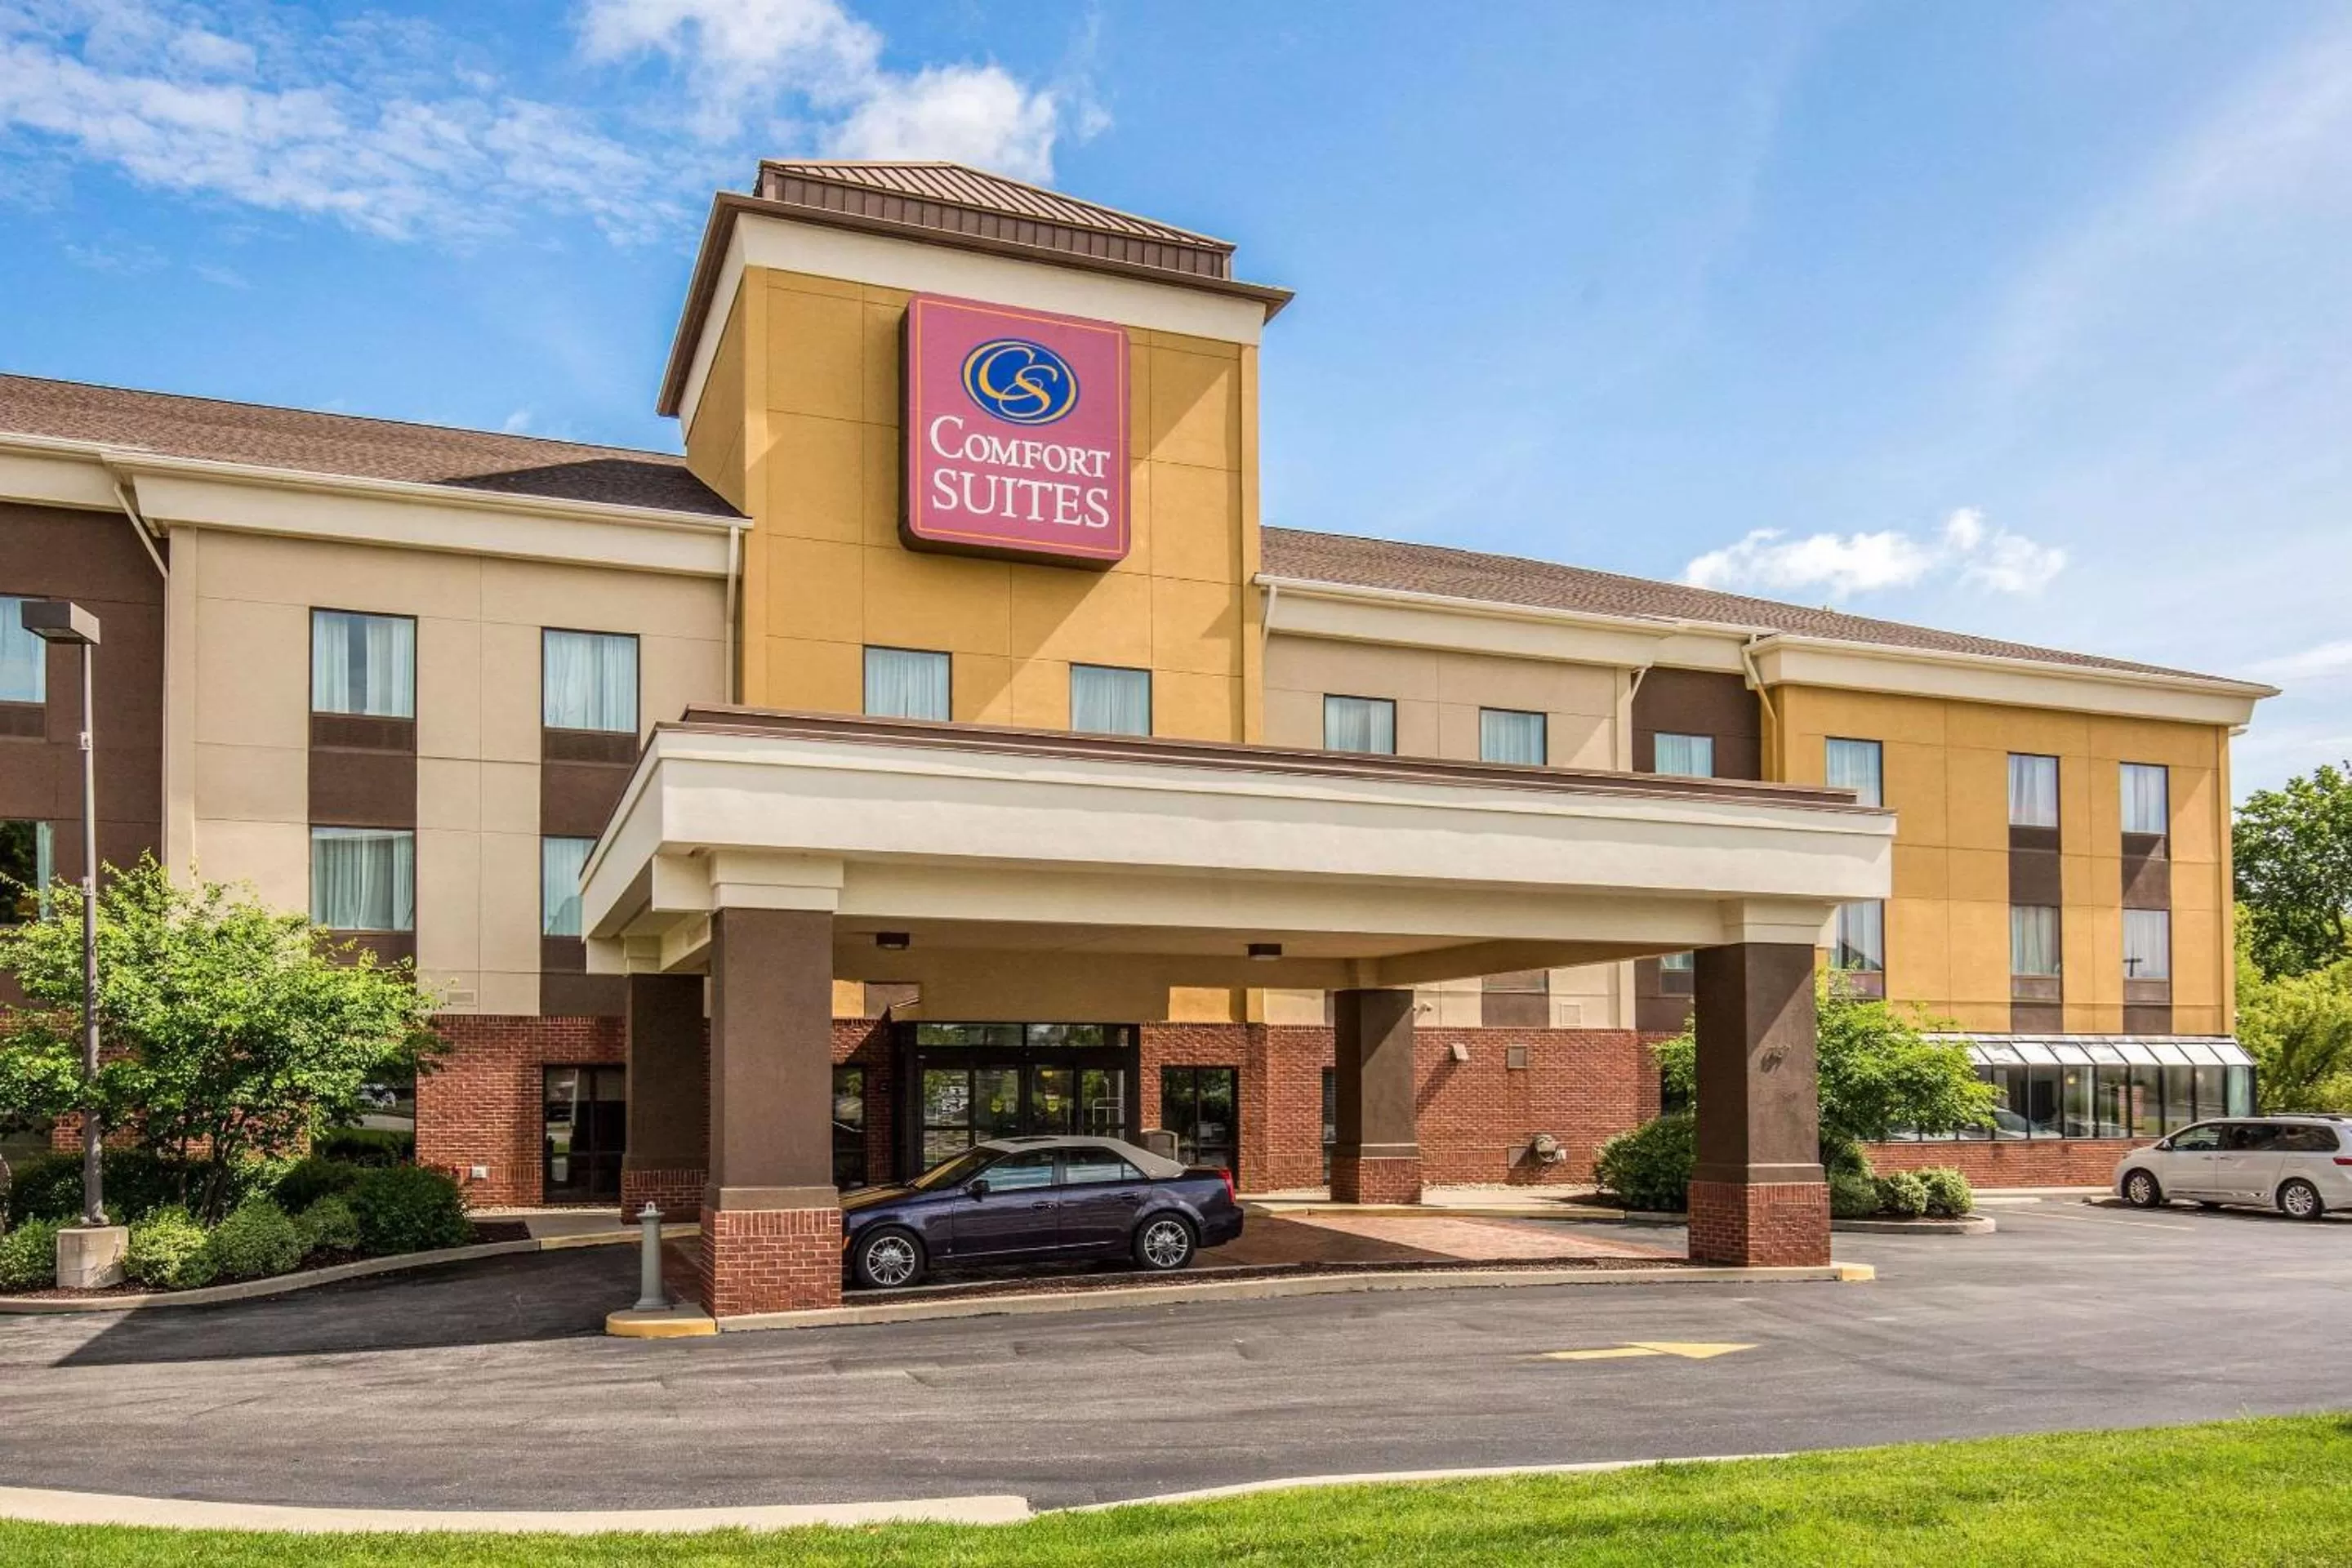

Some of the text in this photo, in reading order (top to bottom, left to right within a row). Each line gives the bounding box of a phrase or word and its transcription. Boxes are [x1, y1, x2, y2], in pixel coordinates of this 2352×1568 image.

[978, 345, 1058, 417] CS
[929, 415, 1111, 479] COMFORT
[932, 468, 1110, 528] SUITES
